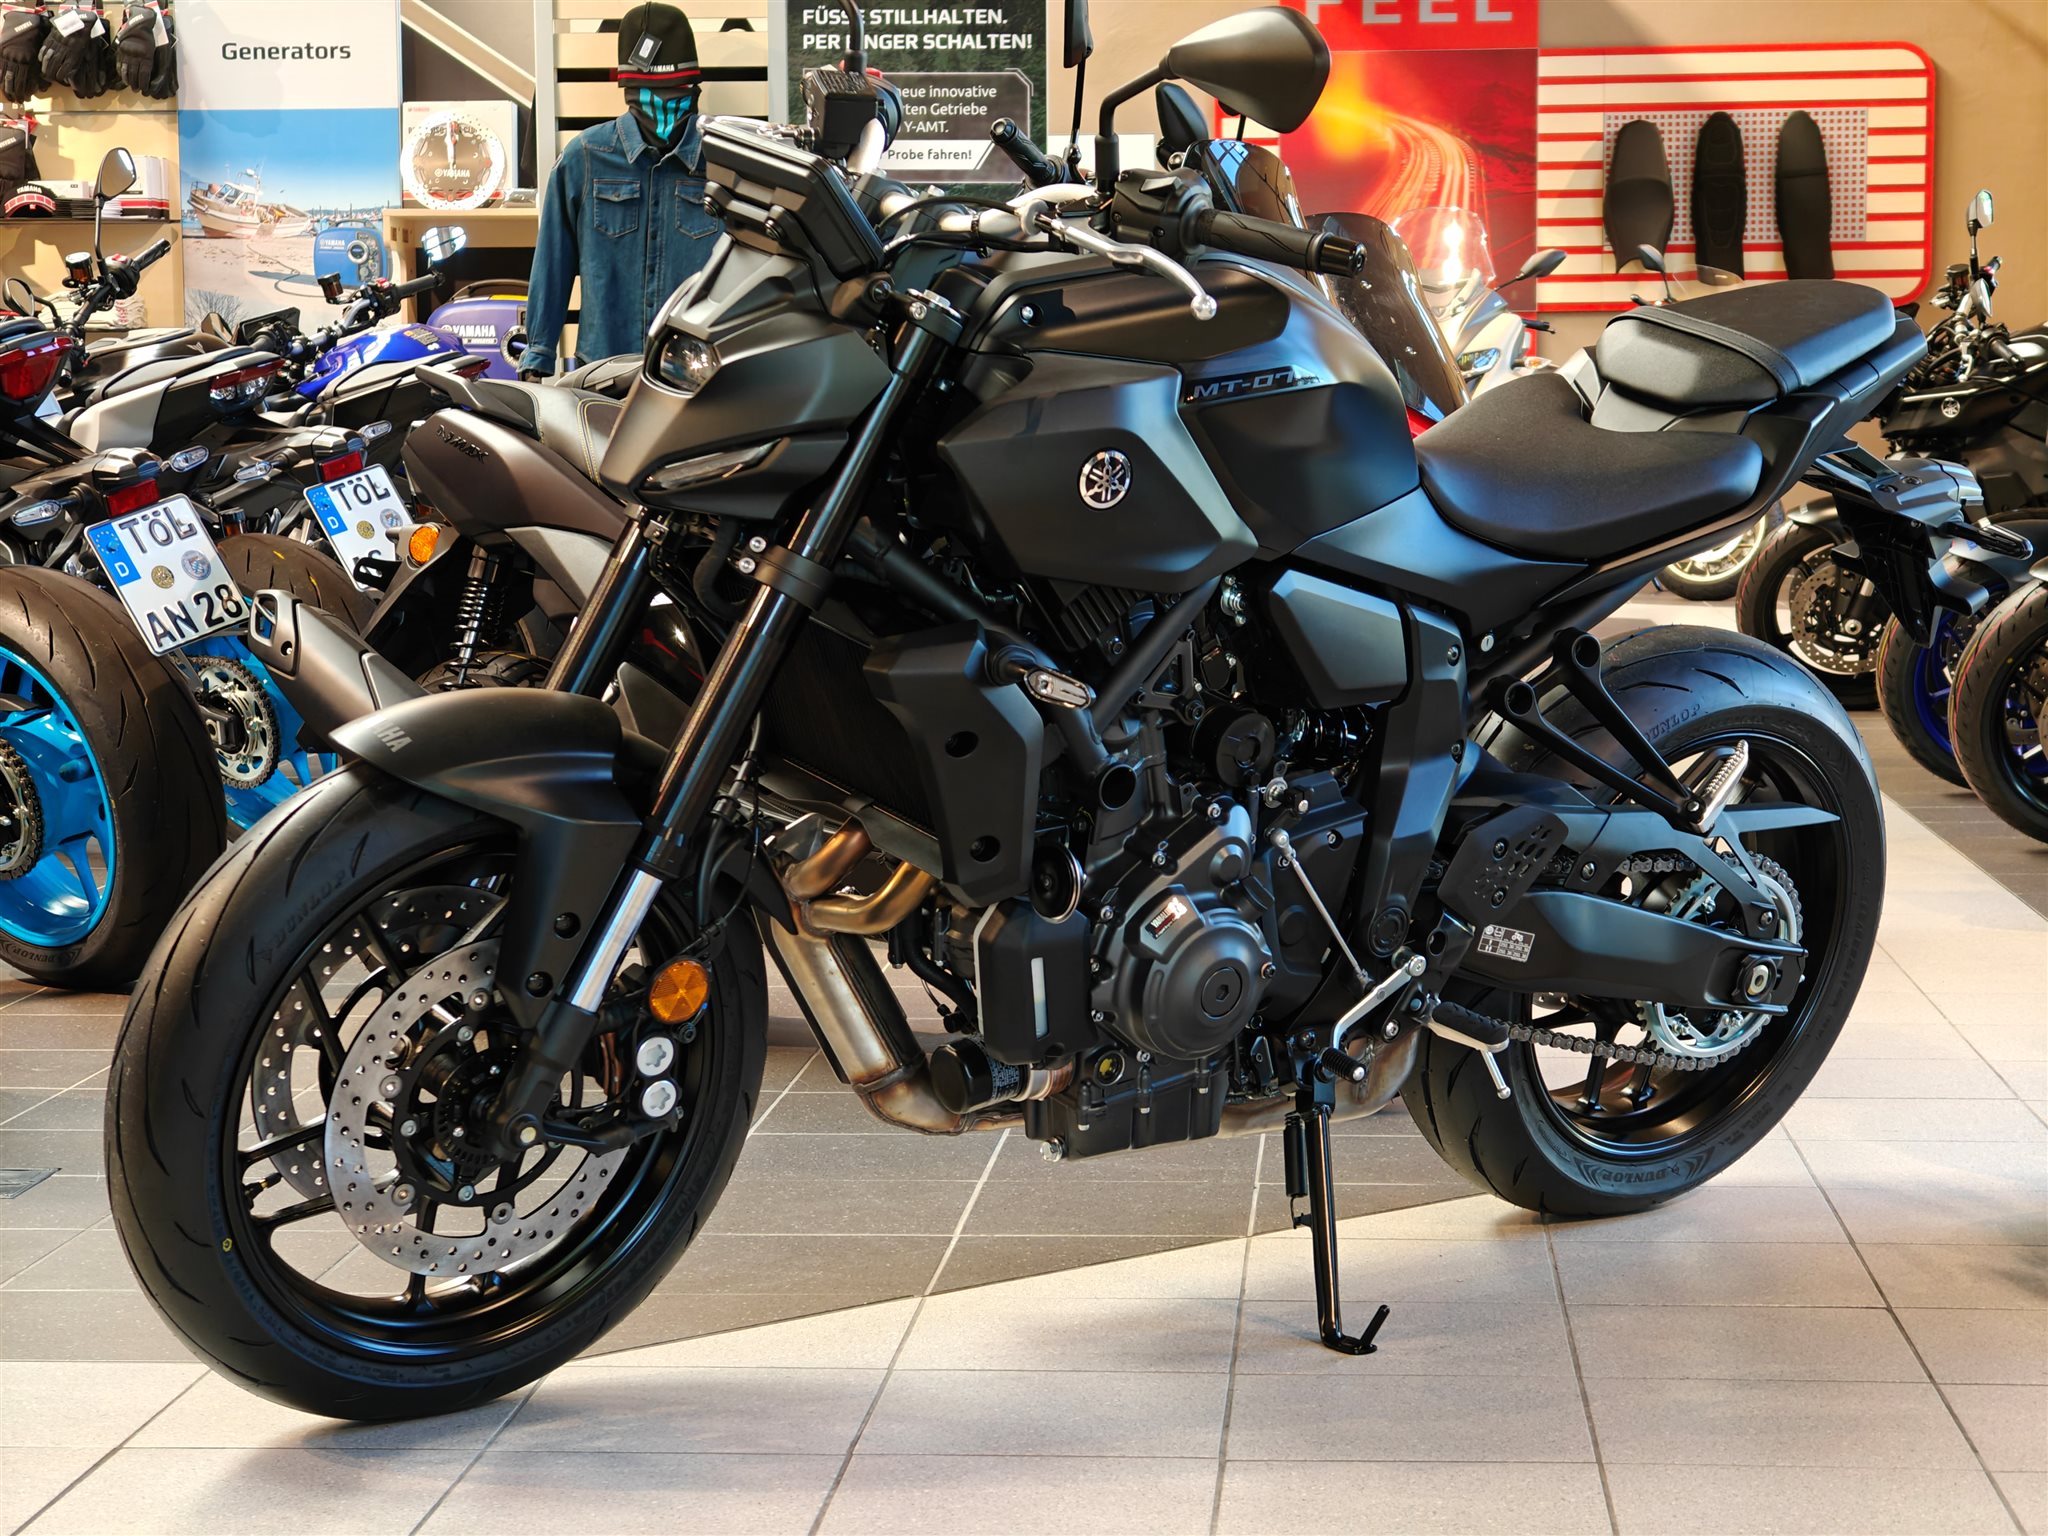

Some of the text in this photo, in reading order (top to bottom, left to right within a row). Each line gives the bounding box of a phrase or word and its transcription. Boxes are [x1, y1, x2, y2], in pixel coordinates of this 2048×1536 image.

[870, 8, 1008, 25] STILLHALTEN.
[803, 33, 1033, 50] PER NGER SCHALTEN!
[221, 42, 351, 60] Generators
[650, 64, 675, 72] YAMAHA
[929, 85, 997, 98] innovative
[930, 103, 988, 115] Getriebe
[904, 121, 949, 133] Y-AMT.
[888, 148, 972, 160] Probe fahren!
[442, 168, 471, 178] YAMAHA
[16, 185, 43, 194] YAMAHA
[452, 324, 496, 338] YAMAHA
[1193, 370, 1295, 398] MT-07
[330, 474, 391, 511] TÖL
[327, 516, 339, 529] D
[118, 507, 198, 554] TÖL
[114, 561, 130, 577] D
[146, 584, 243, 647] AN 28
[1601, 1166, 1668, 1184] DUNLOP
